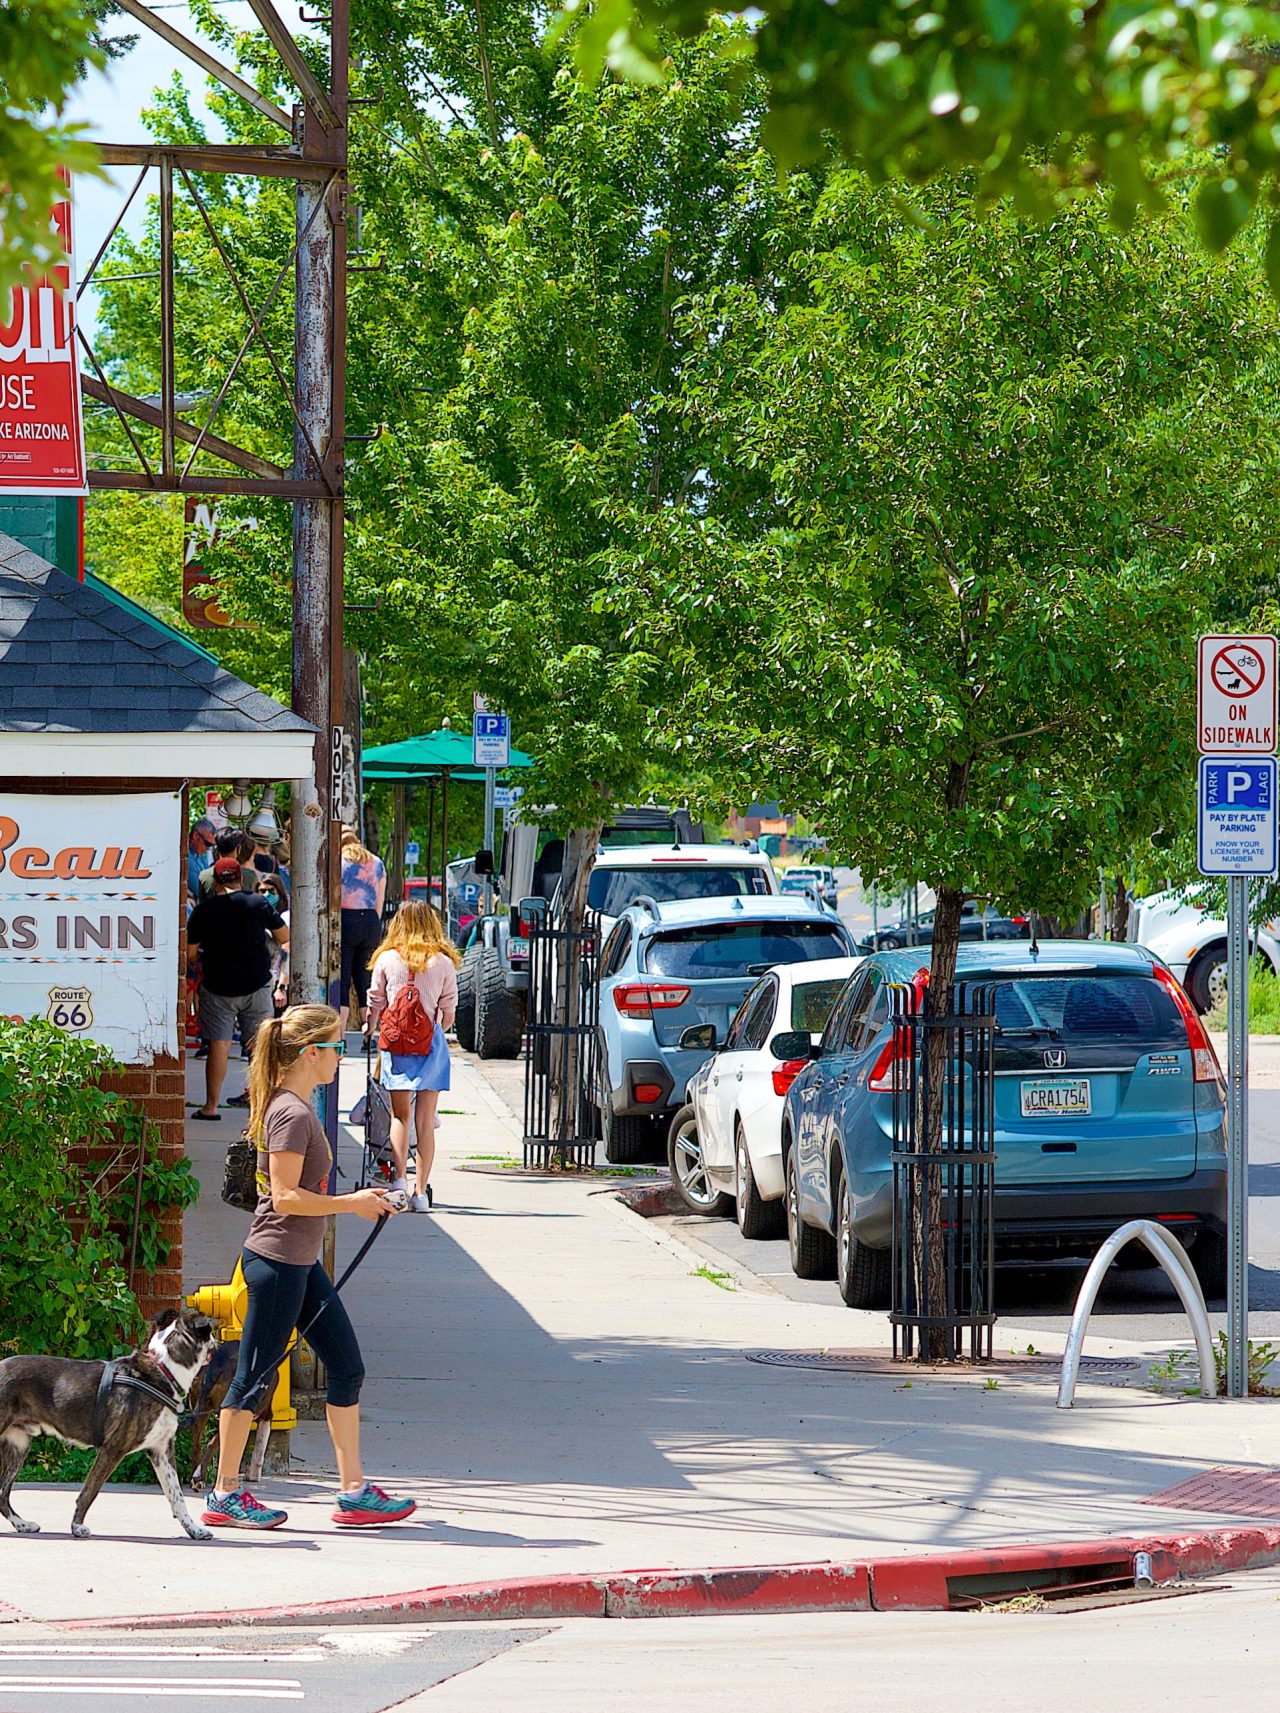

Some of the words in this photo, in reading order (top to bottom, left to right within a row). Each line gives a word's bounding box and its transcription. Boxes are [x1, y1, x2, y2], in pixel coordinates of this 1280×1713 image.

[15, 423, 70, 440] ARIZONA
[1228, 704, 1247, 721] ON
[486, 718, 499, 734] P
[1204, 727, 1271, 744] SIDEWALK
[1208, 770, 1218, 804] PARK
[1227, 771, 1252, 803] P
[1258, 771, 1269, 803] FLAG
[1209, 813, 1226, 822] PAY
[1228, 814, 1239, 822] BY
[1240, 814, 1266, 822] PLATE
[1220, 824, 1256, 832] PARKING
[56, 915, 157, 951] INN
[54, 991, 84, 1000] ROUTE
[53, 1003, 87, 1027] 66
[1031, 1088, 1086, 1107] CRA1754
